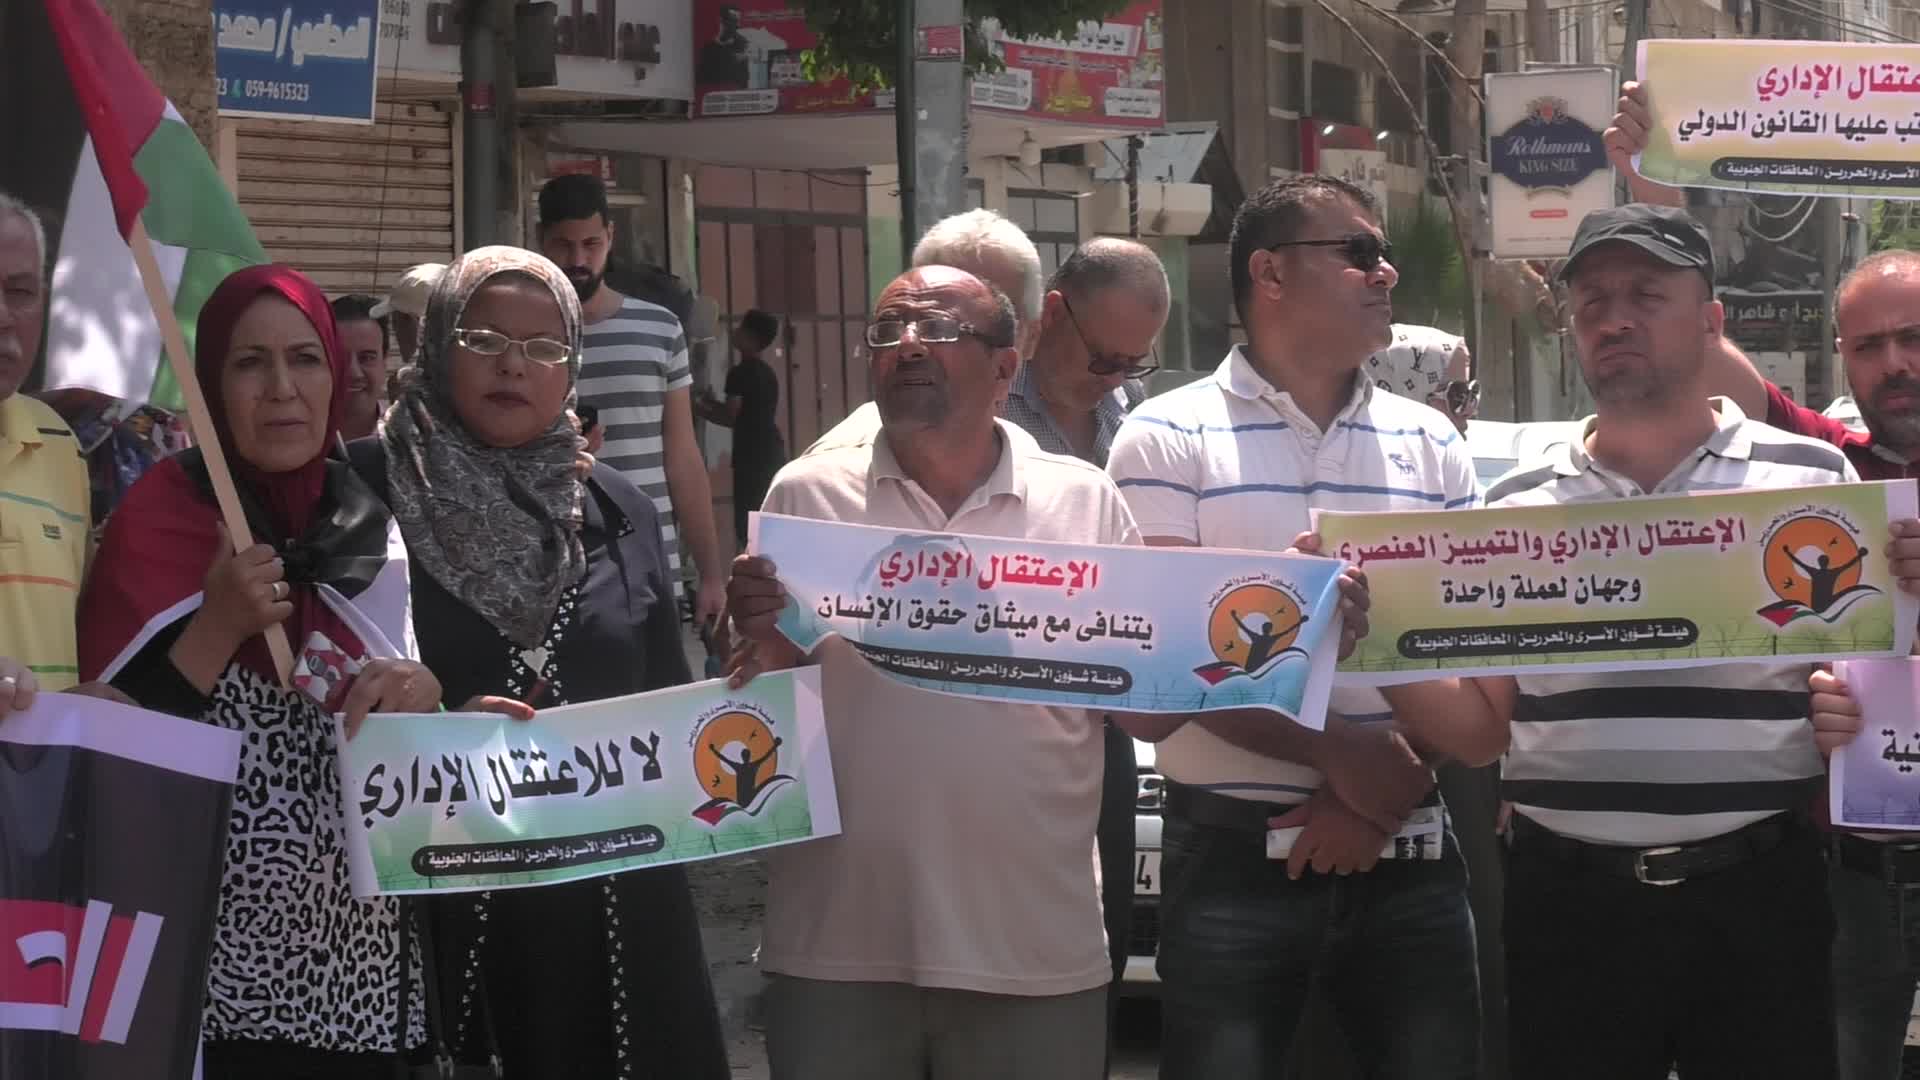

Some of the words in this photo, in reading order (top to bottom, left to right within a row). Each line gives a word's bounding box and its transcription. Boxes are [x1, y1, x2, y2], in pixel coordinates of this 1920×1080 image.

[245, 79, 309, 101] 059-9615323
[1757, 64, 1842, 101] الإداري
[1847, 63, 1920, 100] عتقال
[1678, 108, 1747, 142] الدولي
[1751, 110, 1828, 138] القانون
[1834, 112, 1889, 141] عليها
[1506, 135, 1593, 155] Rothmans
[1519, 159, 1550, 174] KING
[1551, 157, 1578, 173] SIZE
[1441, 528, 1544, 565] والتمييز
[1549, 523, 1630, 564] الإداري
[1638, 517, 1746, 556] الإعتقال
[879, 549, 972, 588] الإداري
[977, 553, 1098, 597] الإعتقال
[1441, 577, 1506, 609] واحدة
[1510, 574, 1568, 600] لعملة
[1574, 573, 1641, 605] وجهان
[817, 594, 902, 628] الإنسان
[908, 598, 967, 630] حقوق
[974, 600, 1038, 638] ميثاق
[1042, 614, 1071, 643] مع
[1075, 610, 1153, 651] يتنافى
[630, 730, 663, 782] لا
[360, 752, 480, 830] الإداري
[486, 739, 624, 816] للاعتقال
